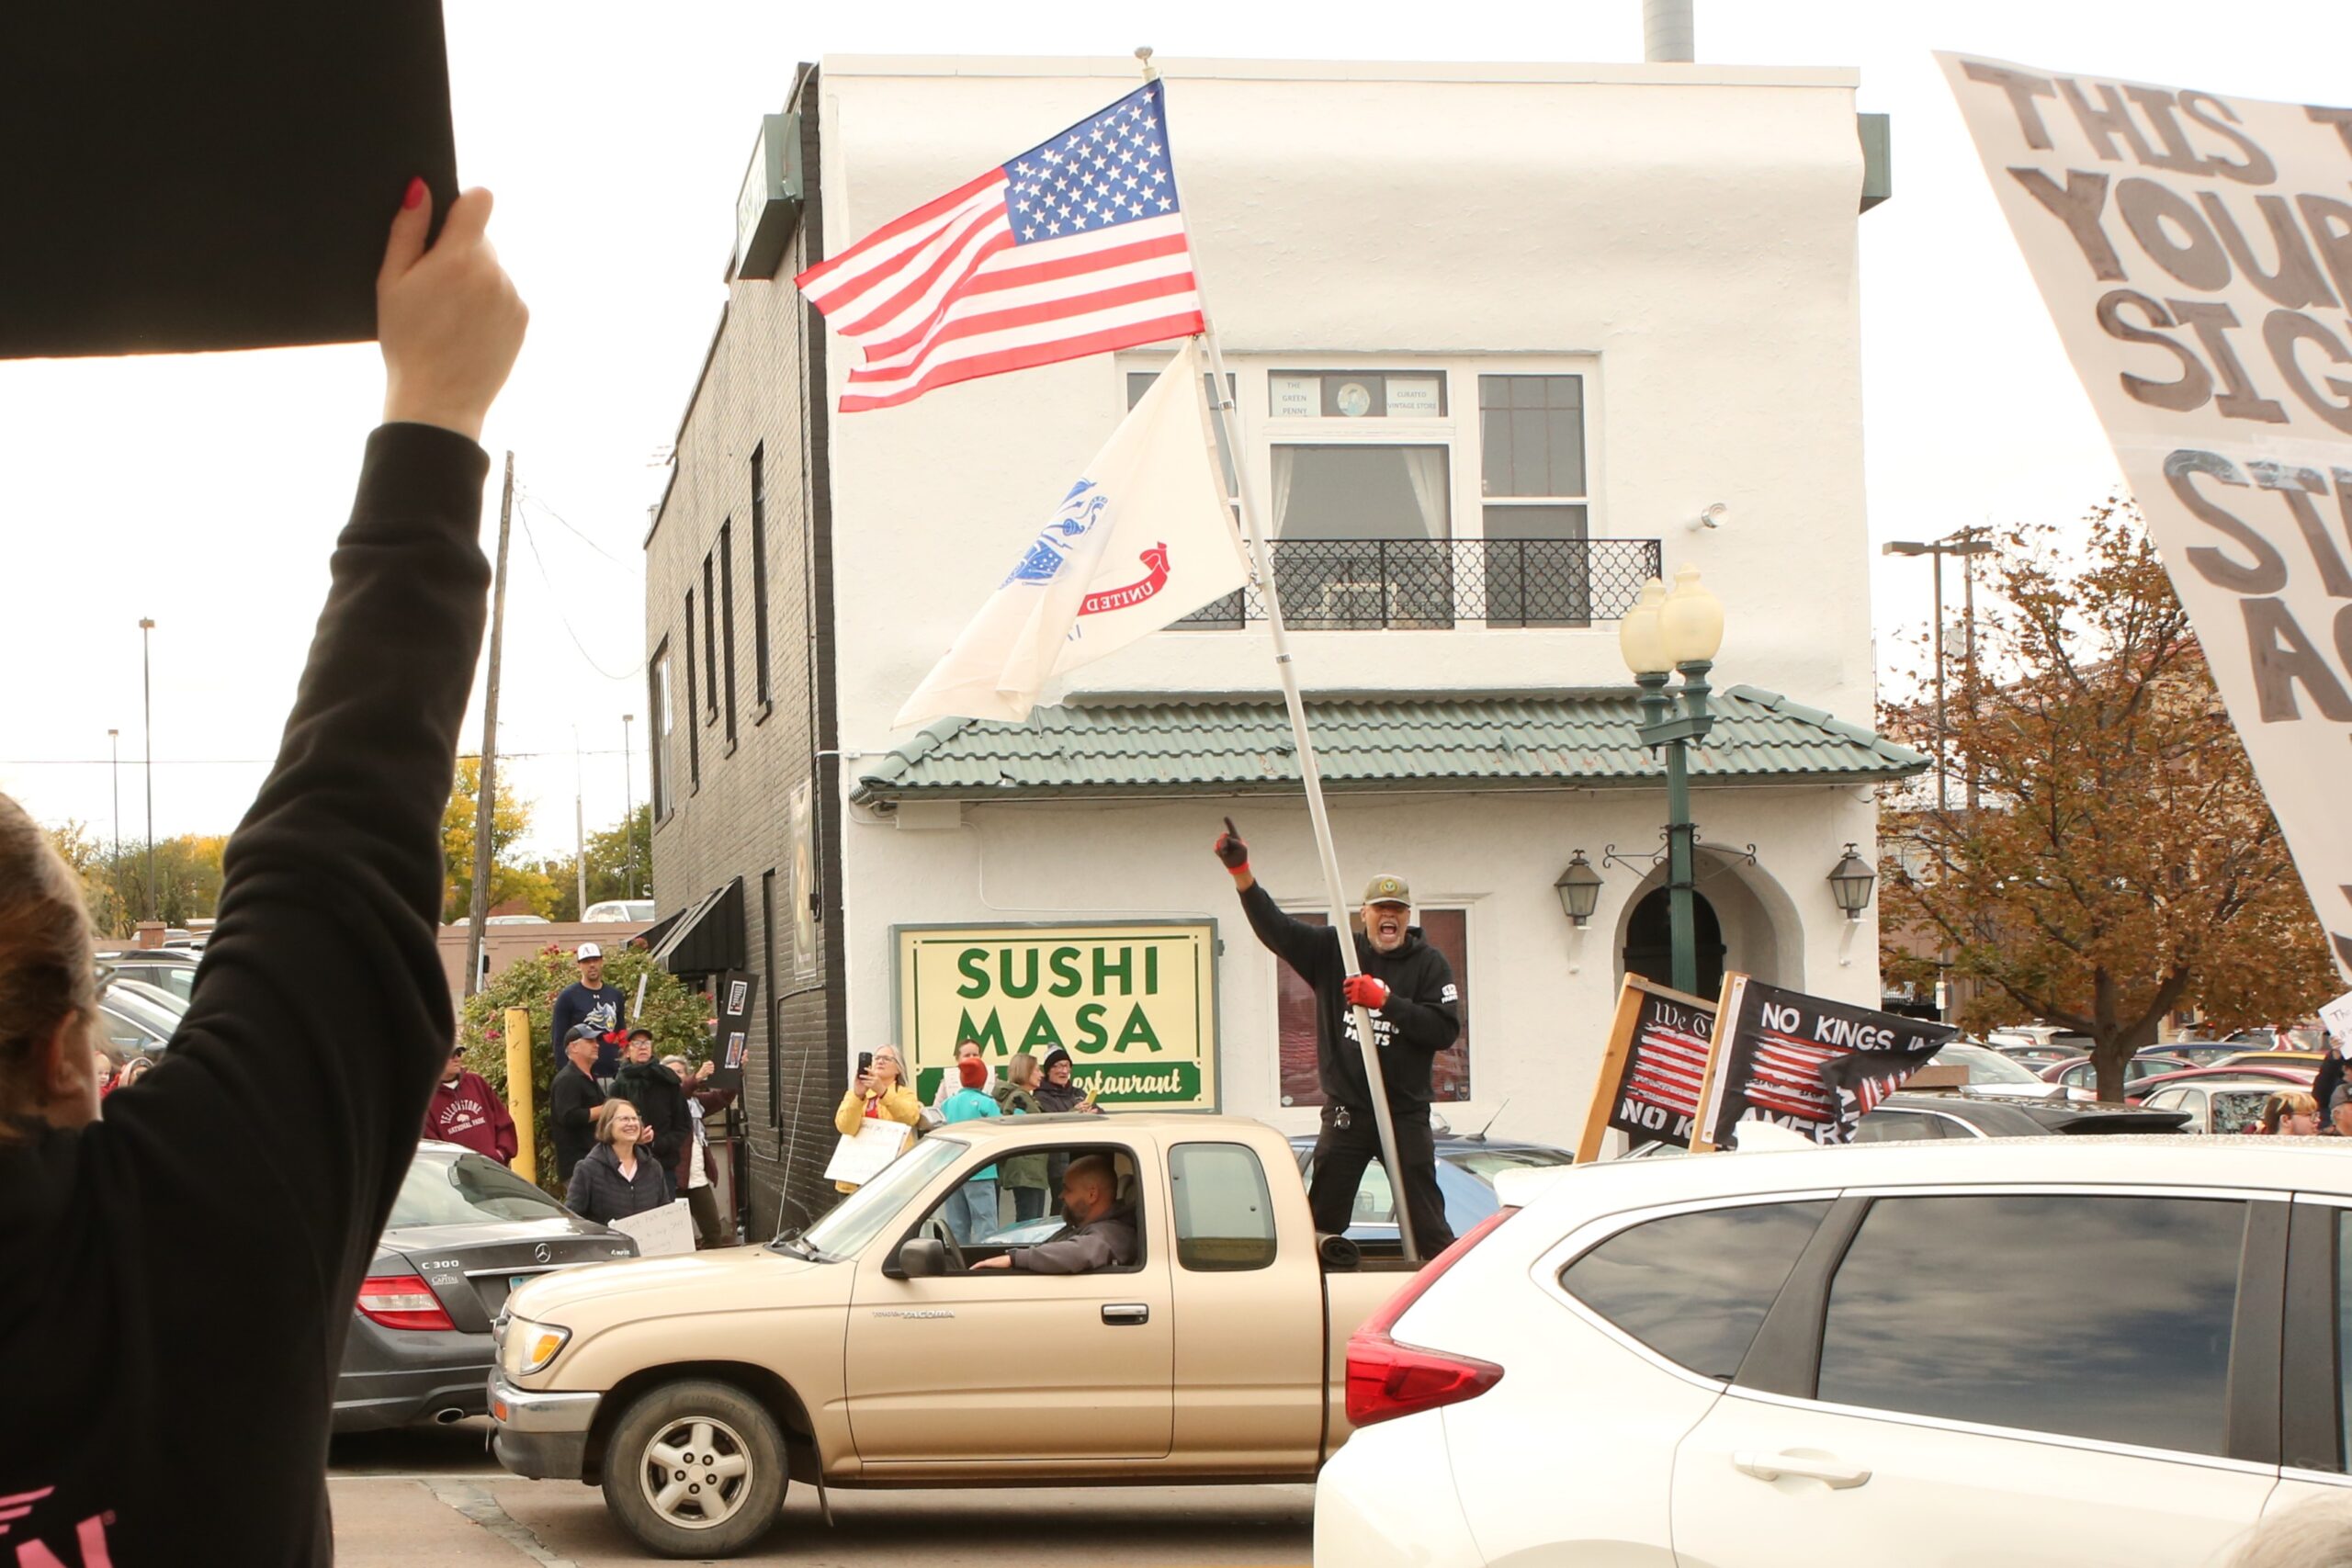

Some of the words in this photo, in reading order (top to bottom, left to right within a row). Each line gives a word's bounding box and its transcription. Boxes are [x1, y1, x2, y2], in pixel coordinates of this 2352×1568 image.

[1960, 59, 2278, 185] THIS
[2096, 288, 2352, 437] SIG
[1283, 407, 1307, 415] PENNY
[2163, 448, 2352, 598] ST
[2240, 598, 2352, 724] A
[956, 946, 1159, 999] SUSHI
[953, 1001, 1163, 1056] MASA
[1655, 1001, 1687, 1031] We
[1693, 1012, 1714, 1038] T
[1761, 1002, 1800, 1035] NO
[1814, 1014, 1895, 1051] KINGS
[1071, 1068, 1182, 1096] estaurant
[447, 1121, 473, 1135] NATIONAL
[471, 1116, 486, 1126] PARK
[1620, 1098, 1668, 1130] NO
[1673, 1114, 1696, 1139] K
[421, 1262, 430, 1270] C
[433, 1259, 459, 1269] 300
[901, 1309, 956, 1319] TACOMA
